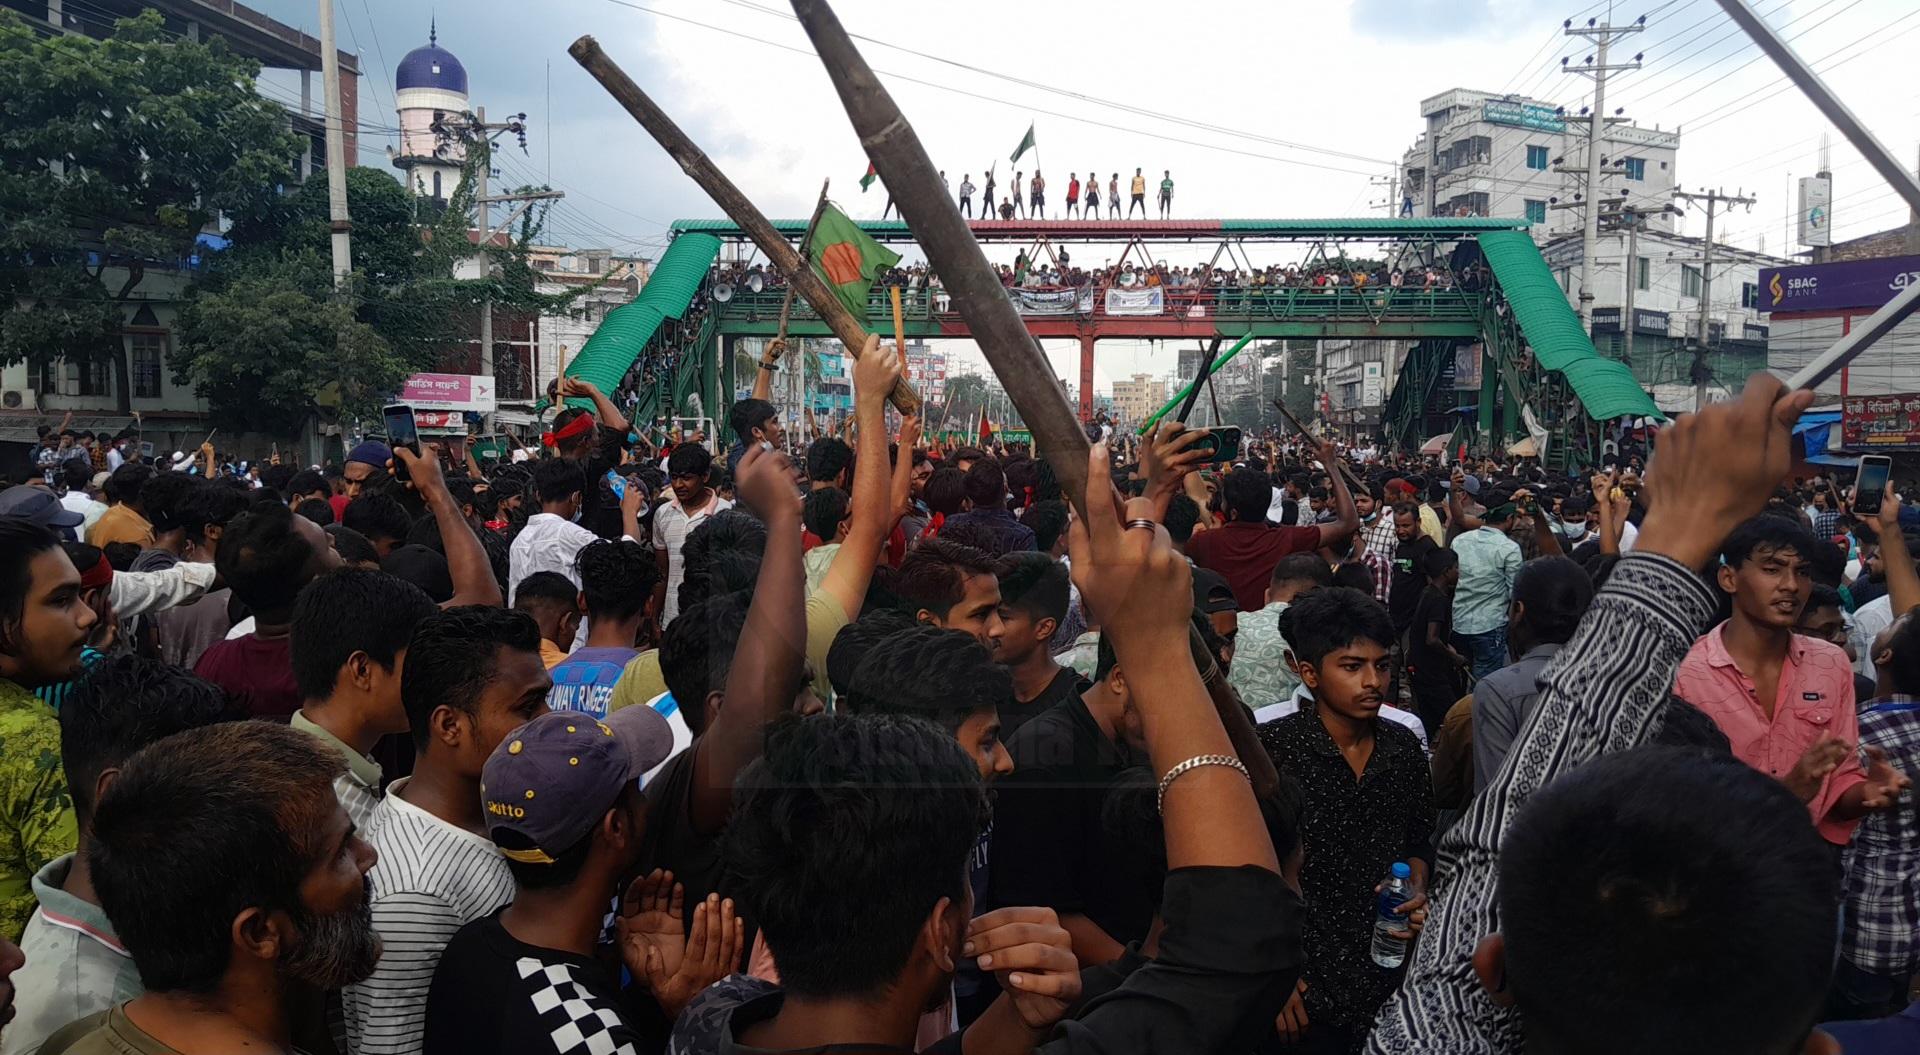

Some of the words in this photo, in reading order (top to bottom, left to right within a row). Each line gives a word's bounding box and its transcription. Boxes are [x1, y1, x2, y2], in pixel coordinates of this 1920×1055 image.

[1788, 277, 1817, 289] SBAC
[1787, 288, 1817, 298] BANK
[1592, 315, 1620, 324] SAMSUNG
[408, 378, 433, 389] সার্ভিস
